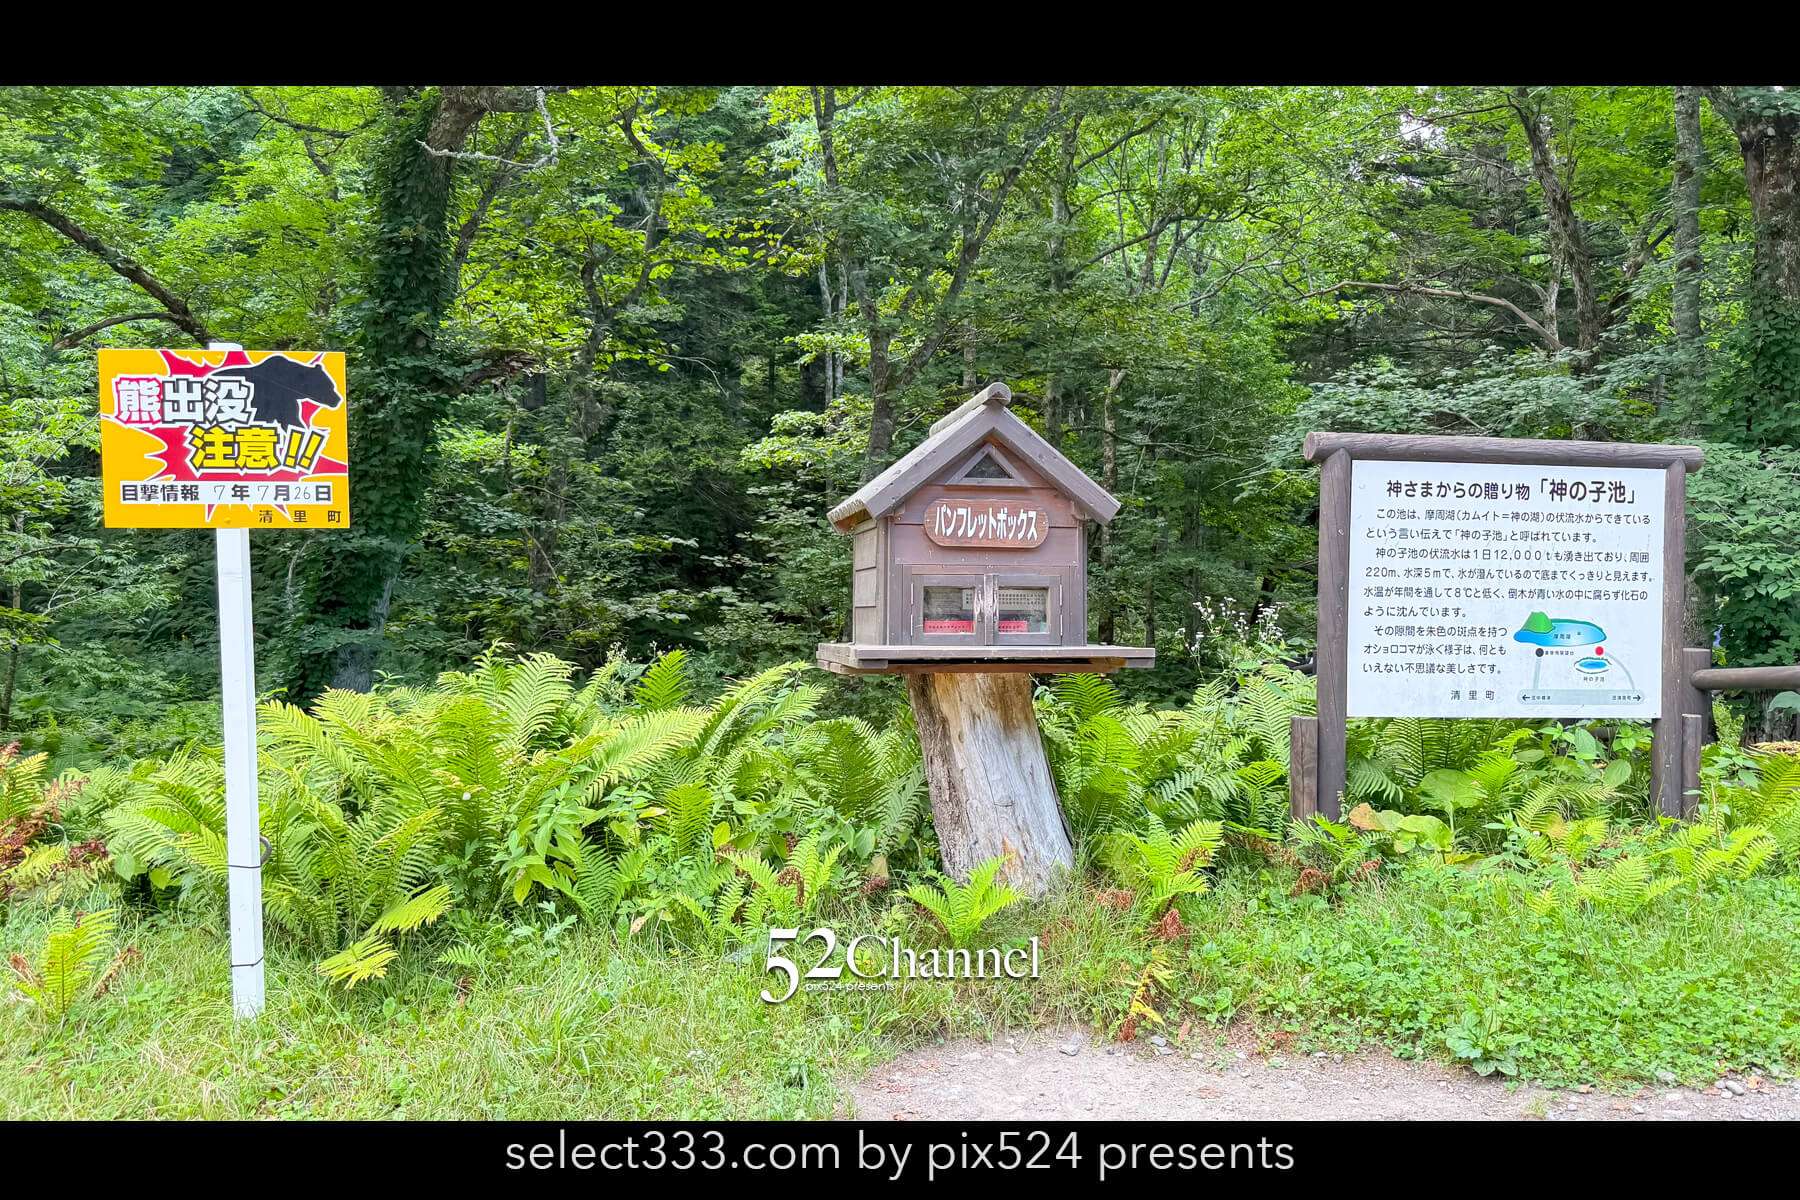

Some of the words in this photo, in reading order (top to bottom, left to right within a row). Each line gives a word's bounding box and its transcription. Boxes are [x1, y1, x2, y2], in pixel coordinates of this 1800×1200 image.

[114, 376, 253, 425] 熊出没
[121, 484, 200, 502] 目撃情報
[1386, 480, 1530, 500] 神さまからの贈り物
[1541, 478, 1635, 504] 「神の子池」
[258, 510, 341, 523] 清里町
[934, 504, 1038, 540] パンフレットボックス
[1366, 528, 1597, 543] という言い伝えで「神の子池」と呼ばれています。
[1363, 606, 1467, 618] ように沈んでいます。
[1374, 625, 1508, 638] その隙間を朱色の斑点を持つ
[1363, 644, 1507, 656] オショロコマが泳ぐ様子は、何とも
[1362, 662, 1501, 675] いえない不思議な美しさです。
[1450, 690, 1495, 701] 清里町
